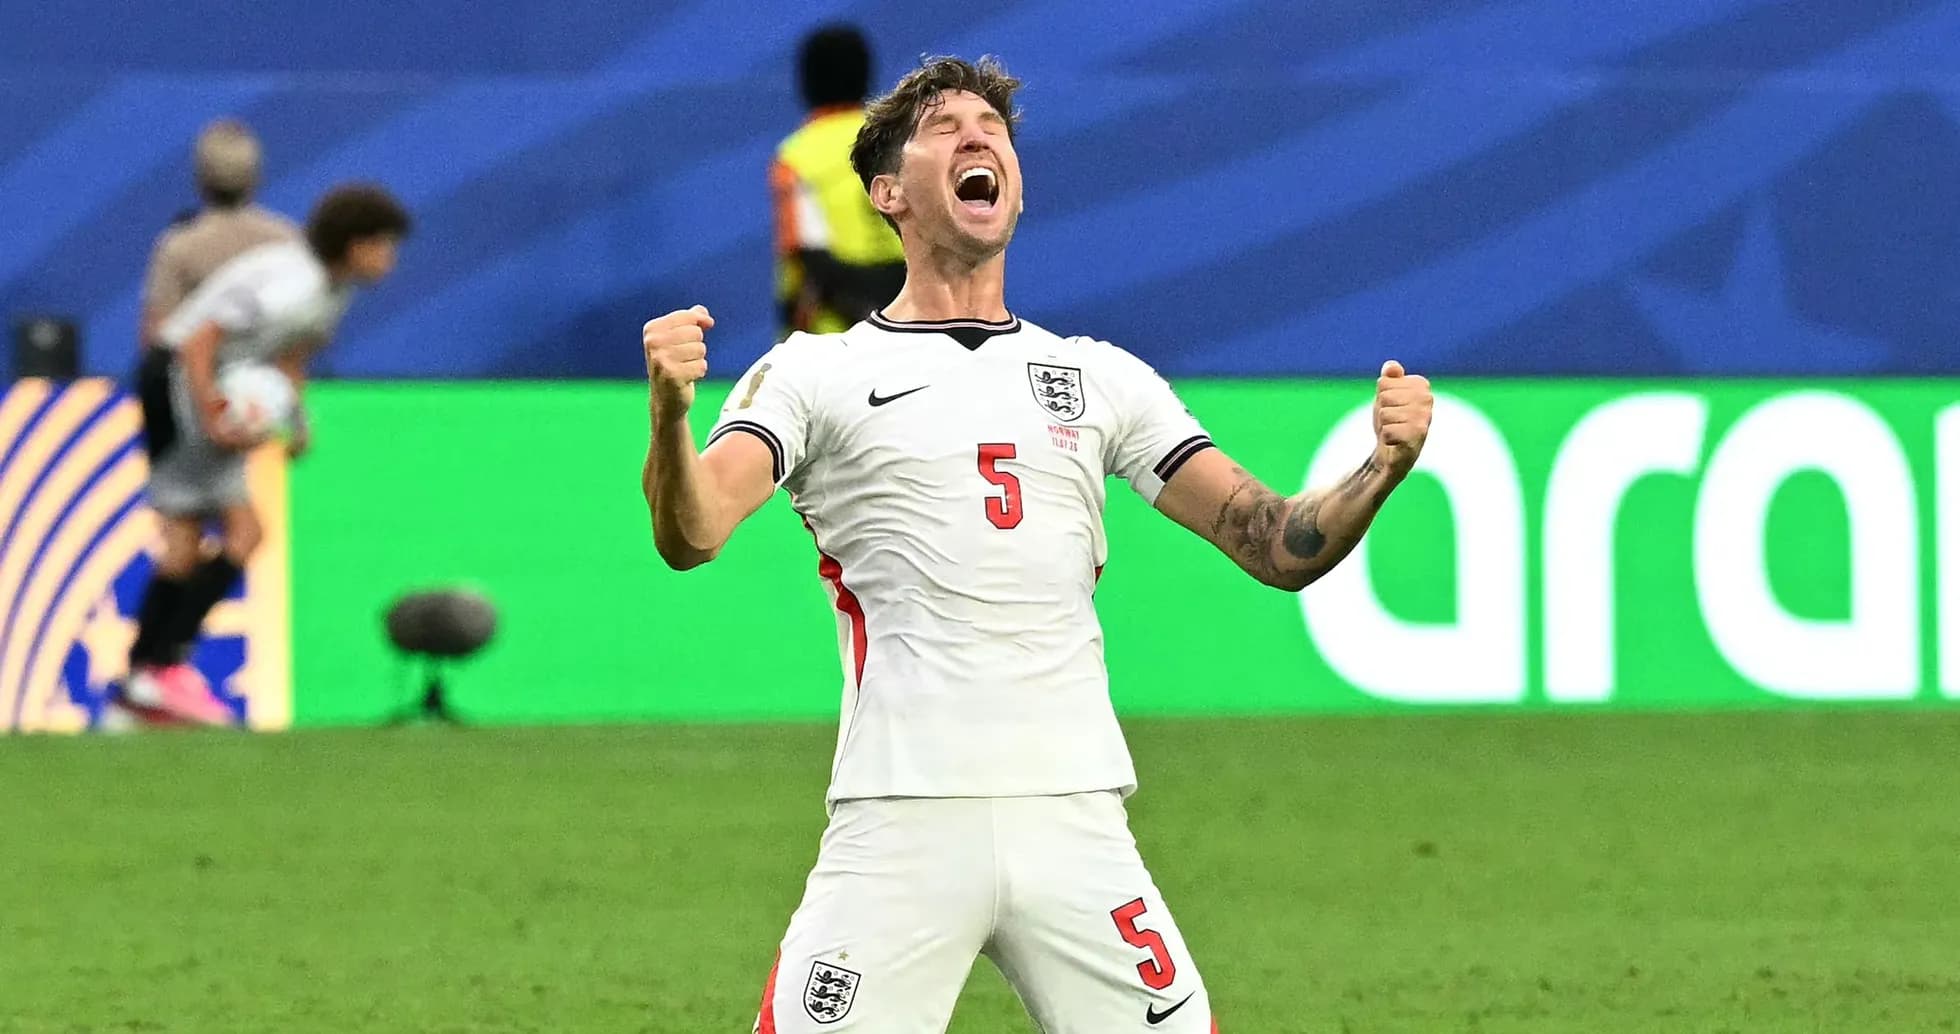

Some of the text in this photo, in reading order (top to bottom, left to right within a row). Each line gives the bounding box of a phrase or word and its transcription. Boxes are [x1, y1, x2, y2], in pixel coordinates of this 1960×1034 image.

[1047, 424, 1080, 440] NORWAY
[977, 443, 1023, 529] 5
[1299, 391, 1960, 702] ara
[1110, 897, 1176, 990] 5
